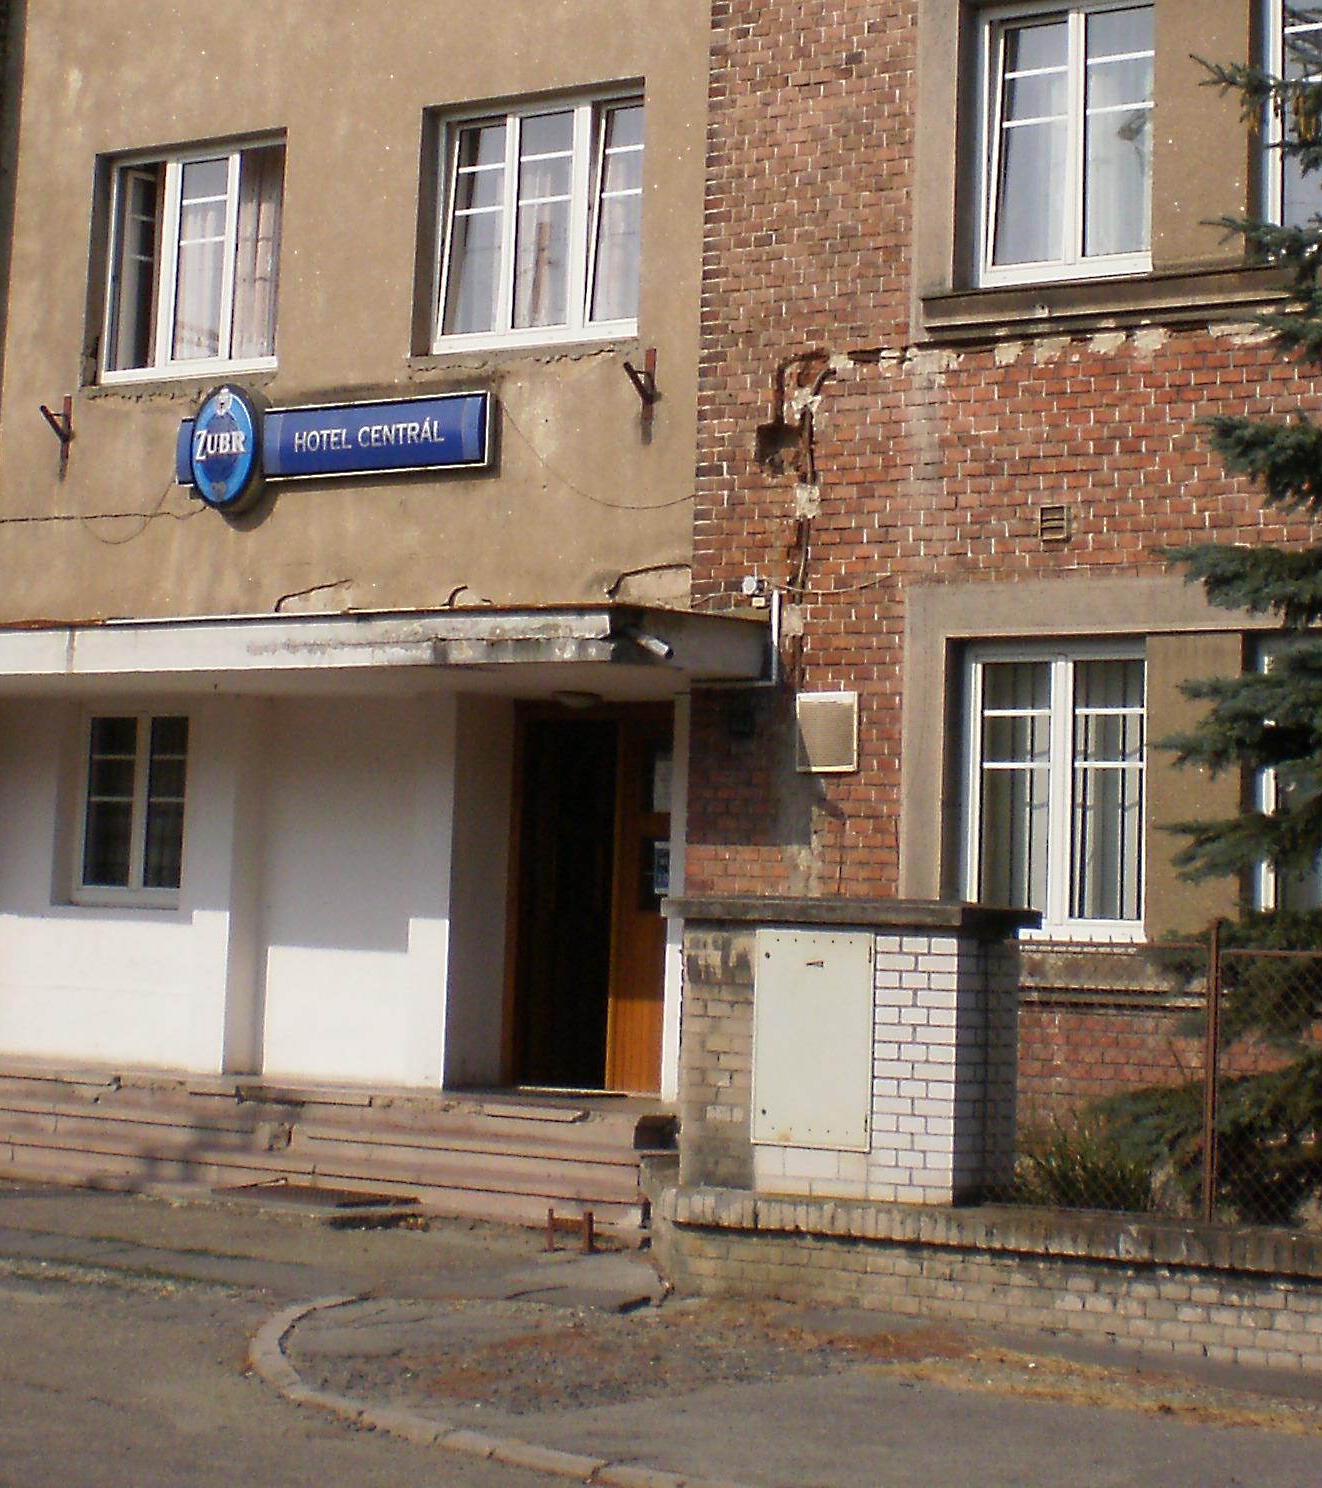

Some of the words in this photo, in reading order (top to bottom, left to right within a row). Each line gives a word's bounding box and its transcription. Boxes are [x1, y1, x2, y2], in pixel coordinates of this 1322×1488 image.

[196, 429, 247, 461] ZUBR
[293, 428, 352, 453] HOTEL
[357, 416, 445, 448] CENTRÁL
